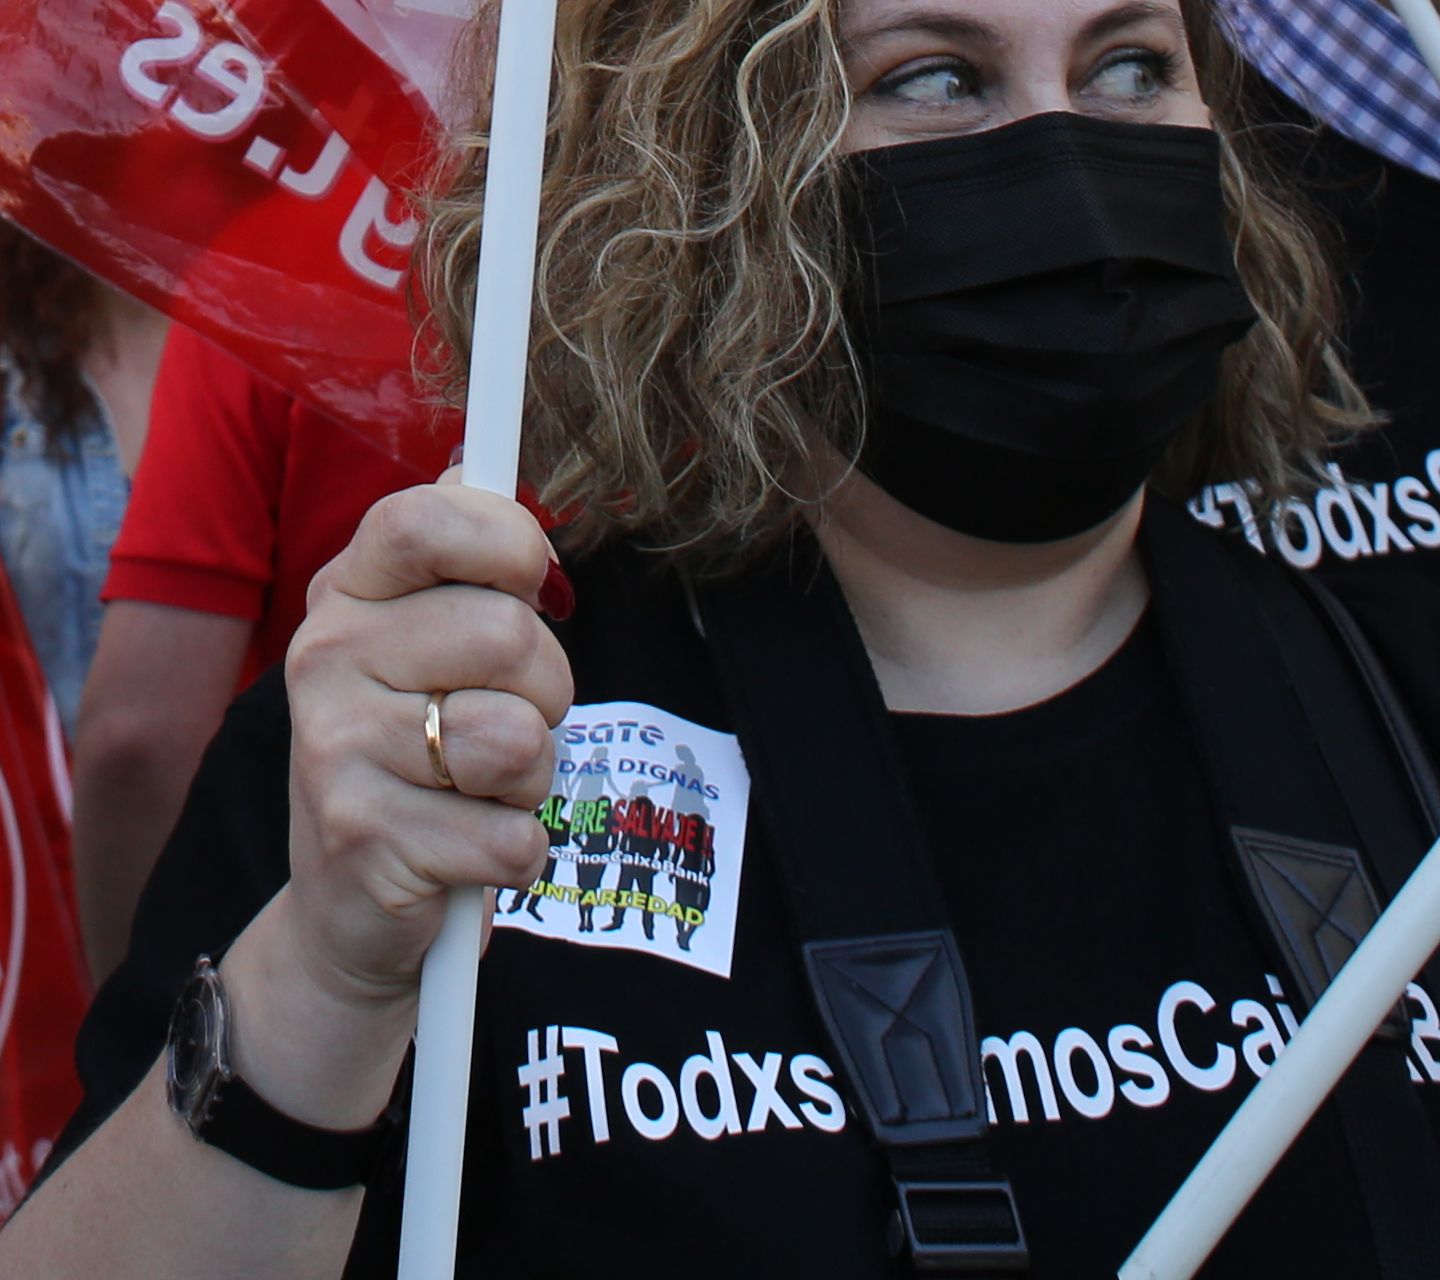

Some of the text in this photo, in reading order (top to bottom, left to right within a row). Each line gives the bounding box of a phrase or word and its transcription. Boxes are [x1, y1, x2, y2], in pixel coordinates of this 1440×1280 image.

[617, 757, 720, 801] DIGNAS
[570, 799, 609, 834] ERE
[611, 798, 699, 854] SALVAJE
